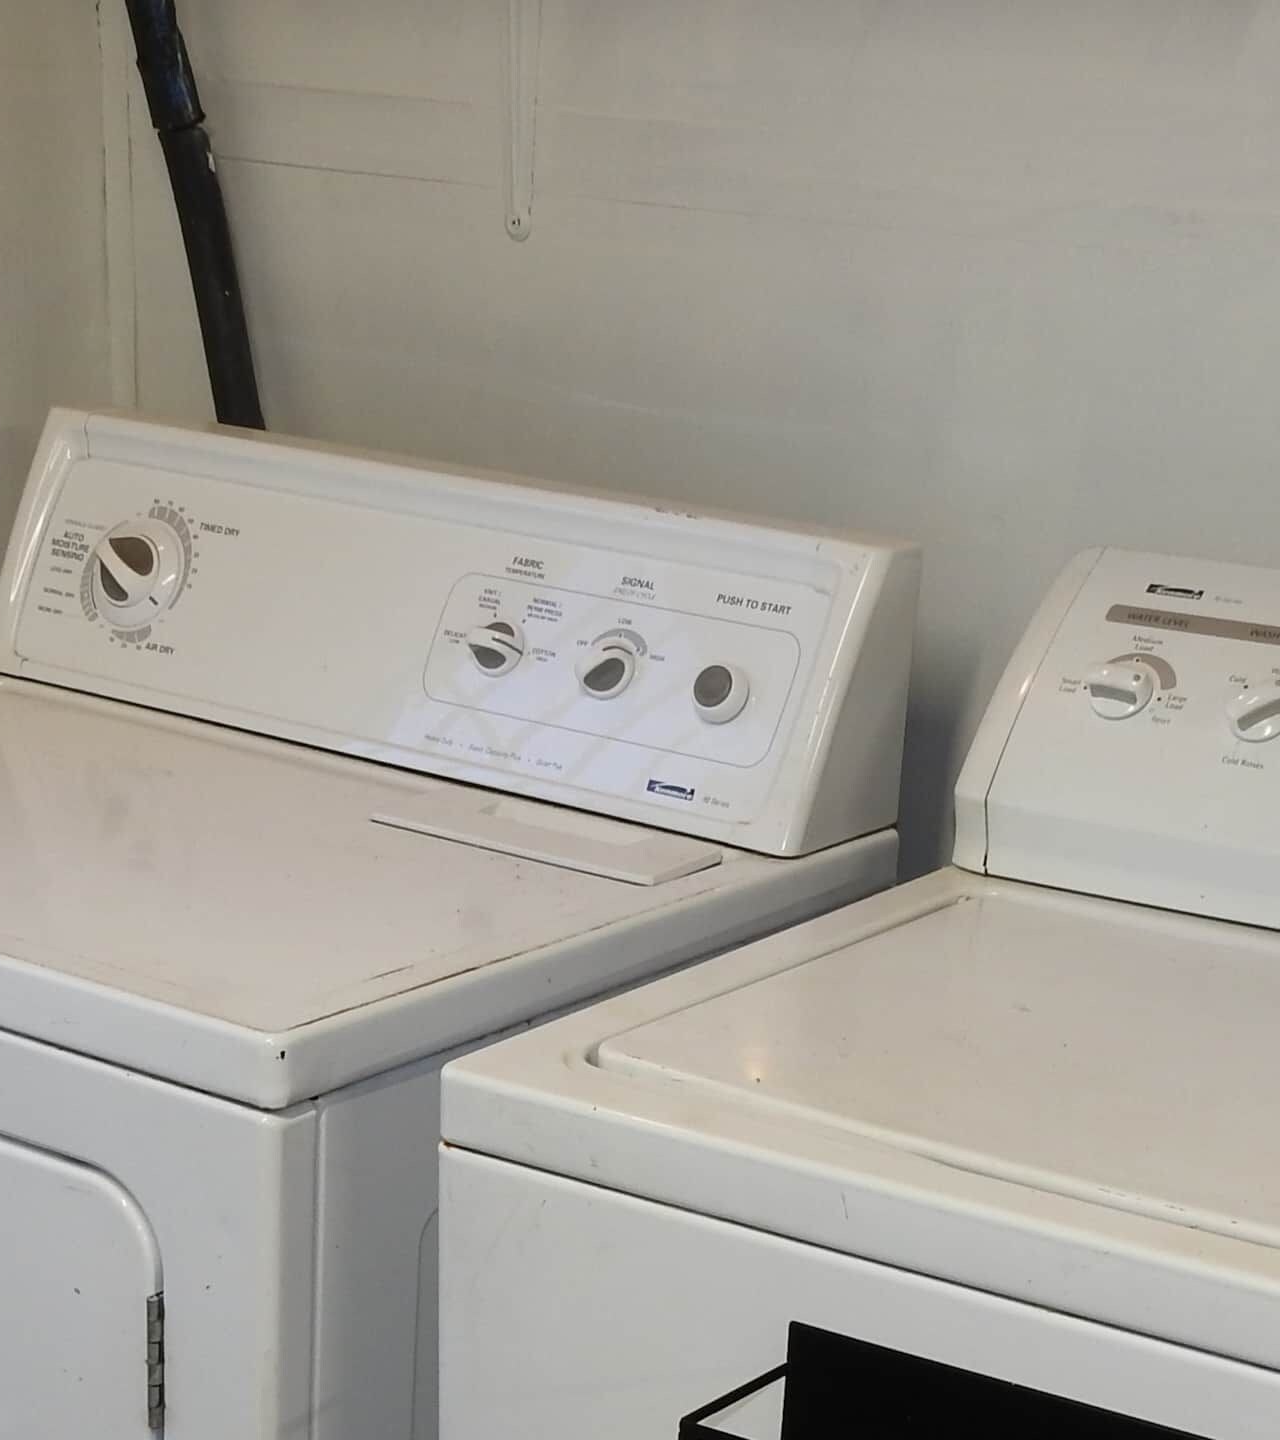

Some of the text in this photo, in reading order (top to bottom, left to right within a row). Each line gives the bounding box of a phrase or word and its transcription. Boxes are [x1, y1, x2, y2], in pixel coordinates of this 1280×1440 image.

[64, 530, 84, 541] AUTO
[224, 525, 240, 536] DRY
[512, 556, 544, 570] FABRIC
[621, 576, 654, 590] SIGNAL
[716, 593, 792, 615] PUSH TO START
[1128, 612, 1190, 629] WATER LEVEL
[159, 645, 175, 655] DRY
